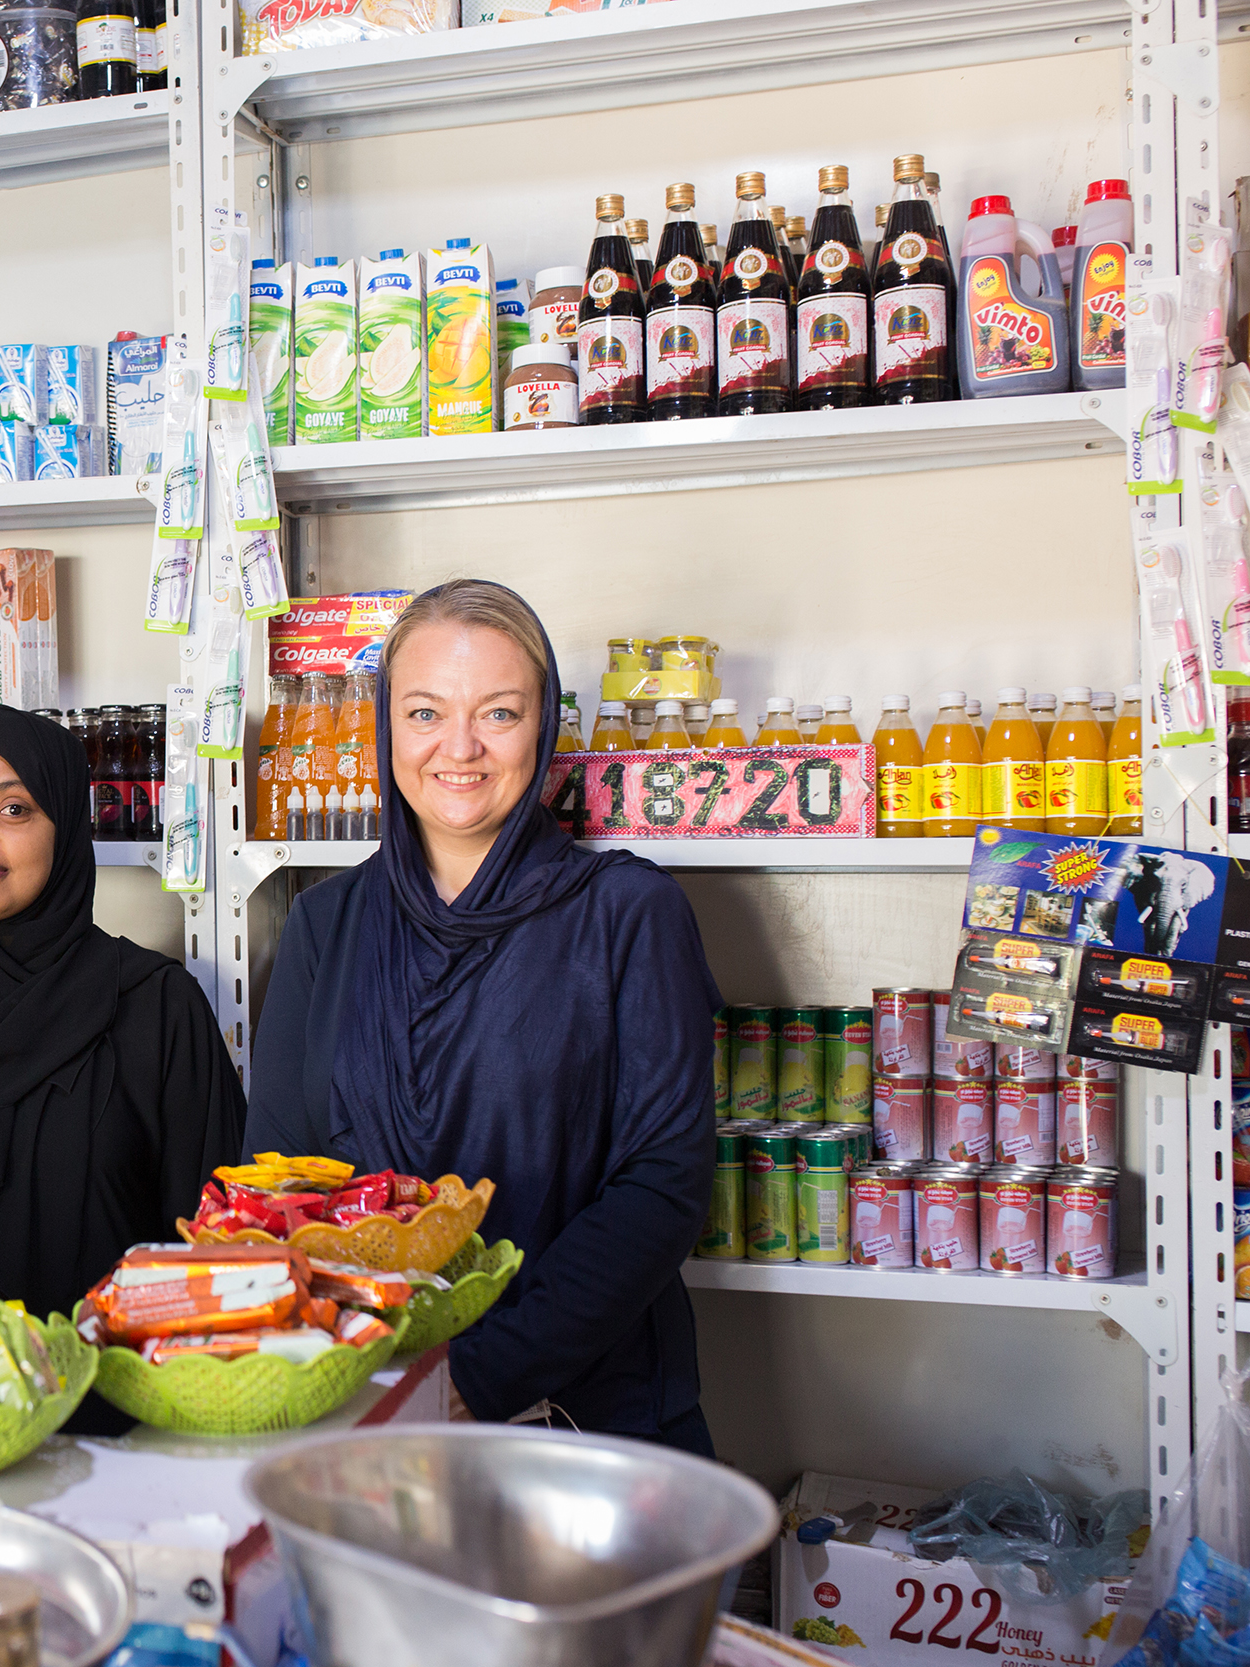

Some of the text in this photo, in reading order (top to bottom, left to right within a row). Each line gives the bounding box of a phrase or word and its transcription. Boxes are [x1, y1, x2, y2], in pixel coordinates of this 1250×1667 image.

[257, 0, 360, 38] TODAY
[479, 12, 495, 24] X4
[214, 207, 242, 219] COOR
[443, 267, 474, 280] BEYTI
[1094, 259, 1116, 275] Enjoy
[310, 282, 342, 294] BEYTI
[374, 276, 406, 288] BEYTI
[975, 273, 997, 289] Enjoy
[496, 303, 519, 315] EYTI
[544, 303, 579, 315] LOVELL
[974, 301, 1042, 346] Vimto
[124, 344, 158, 358] المراعي
[125, 362, 159, 374] Almarai
[517, 381, 561, 394] LOVELLA
[1175, 359, 1187, 410] COBOR
[115, 380, 165, 412] حليب
[369, 407, 410, 424] GOYAVE
[436, 400, 483, 418] MANGUE
[305, 411, 346, 428] GOYAVE
[1131, 430, 1142, 481] COBOR
[242, 564, 255, 608] COBOR
[148, 576, 162, 618] COBOR
[1214, 619, 1224, 670] COBOR
[273, 646, 350, 665] Colgate
[201, 699, 214, 744] COBOR
[877, 767, 913, 786] Ahlan
[1013, 763, 1043, 782] Ahlan
[549, 757, 844, 840] 418720
[1015, 860, 1042, 870] ARAFA
[1054, 852, 1089, 875] SUPER
[1056, 859, 1099, 885] STRONG
[1000, 942, 1035, 956] SUPER
[1091, 951, 1115, 961] ARAFA
[1128, 961, 1165, 977] SUPER
[1224, 971, 1249, 981] ARAFA
[1102, 991, 1130, 1001] Material
[1082, 1006, 1106, 1016] ARAFA
[1119, 1015, 1156, 1032] SUPER
[818, 1593, 837, 1604] FIBER
[889, 1577, 1002, 1655] 222
[995, 1621, 1044, 1649] Honey
